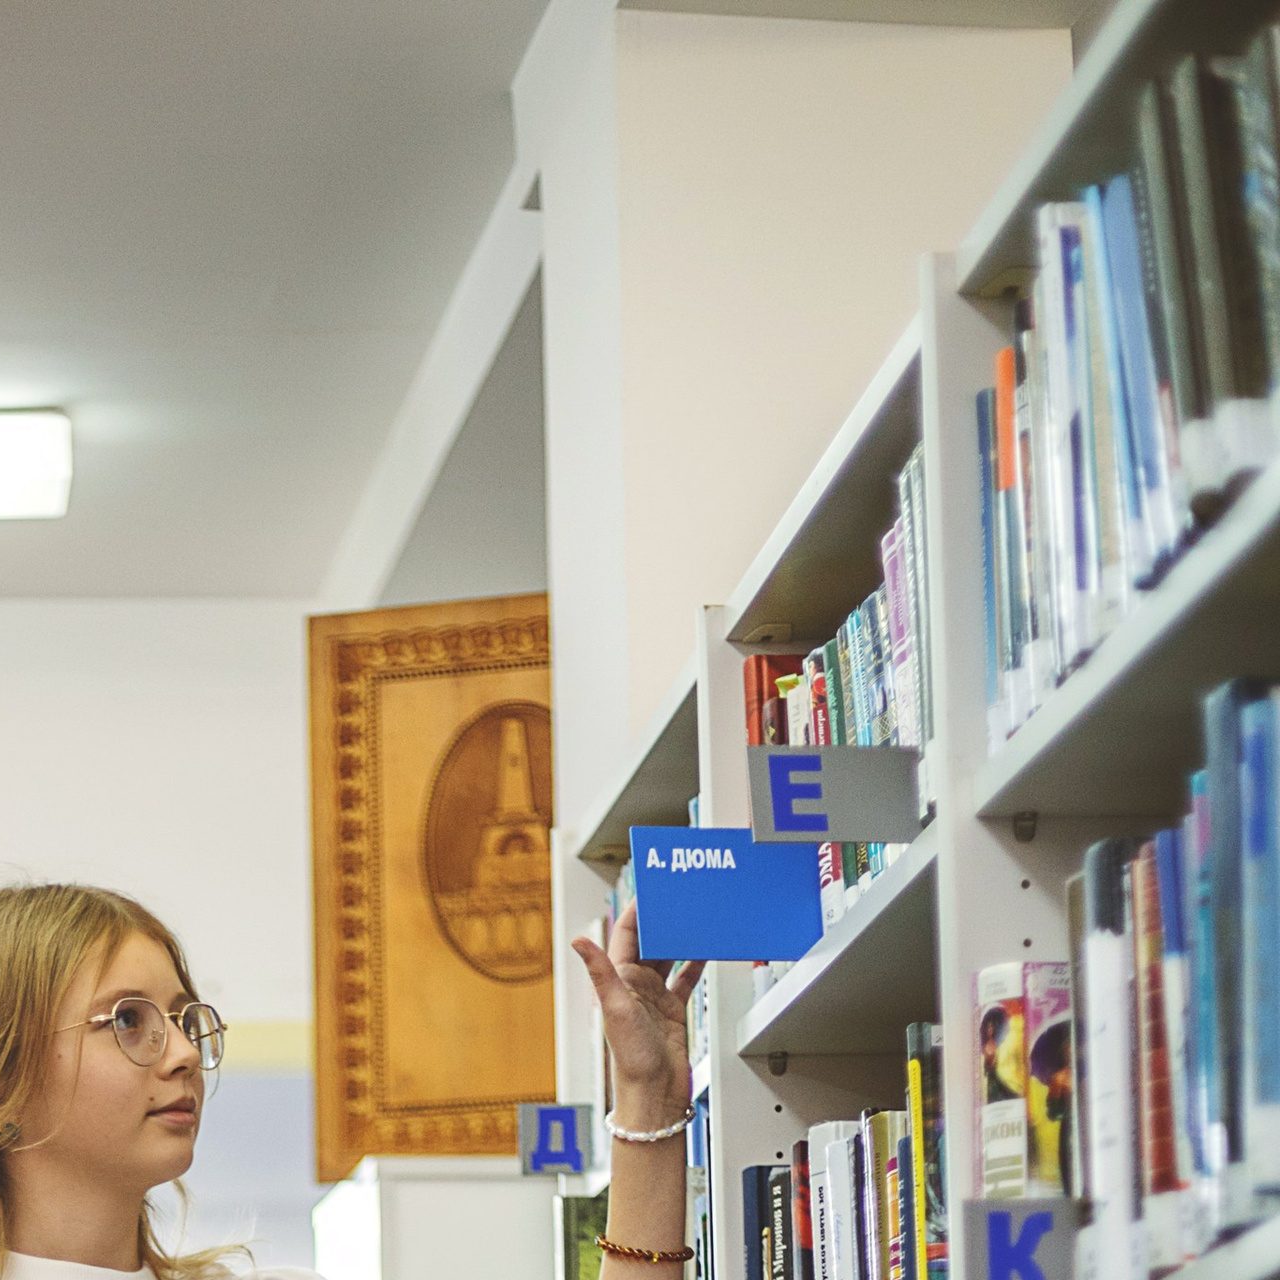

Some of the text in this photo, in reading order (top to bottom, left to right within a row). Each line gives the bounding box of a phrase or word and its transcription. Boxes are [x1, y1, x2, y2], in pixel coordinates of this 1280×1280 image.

[768, 754, 829, 831] Е
[646, 848, 736, 872] А. ДЮМА
[531, 1107, 583, 1171] Д
[772, 1209, 787, 1273] Миронов
